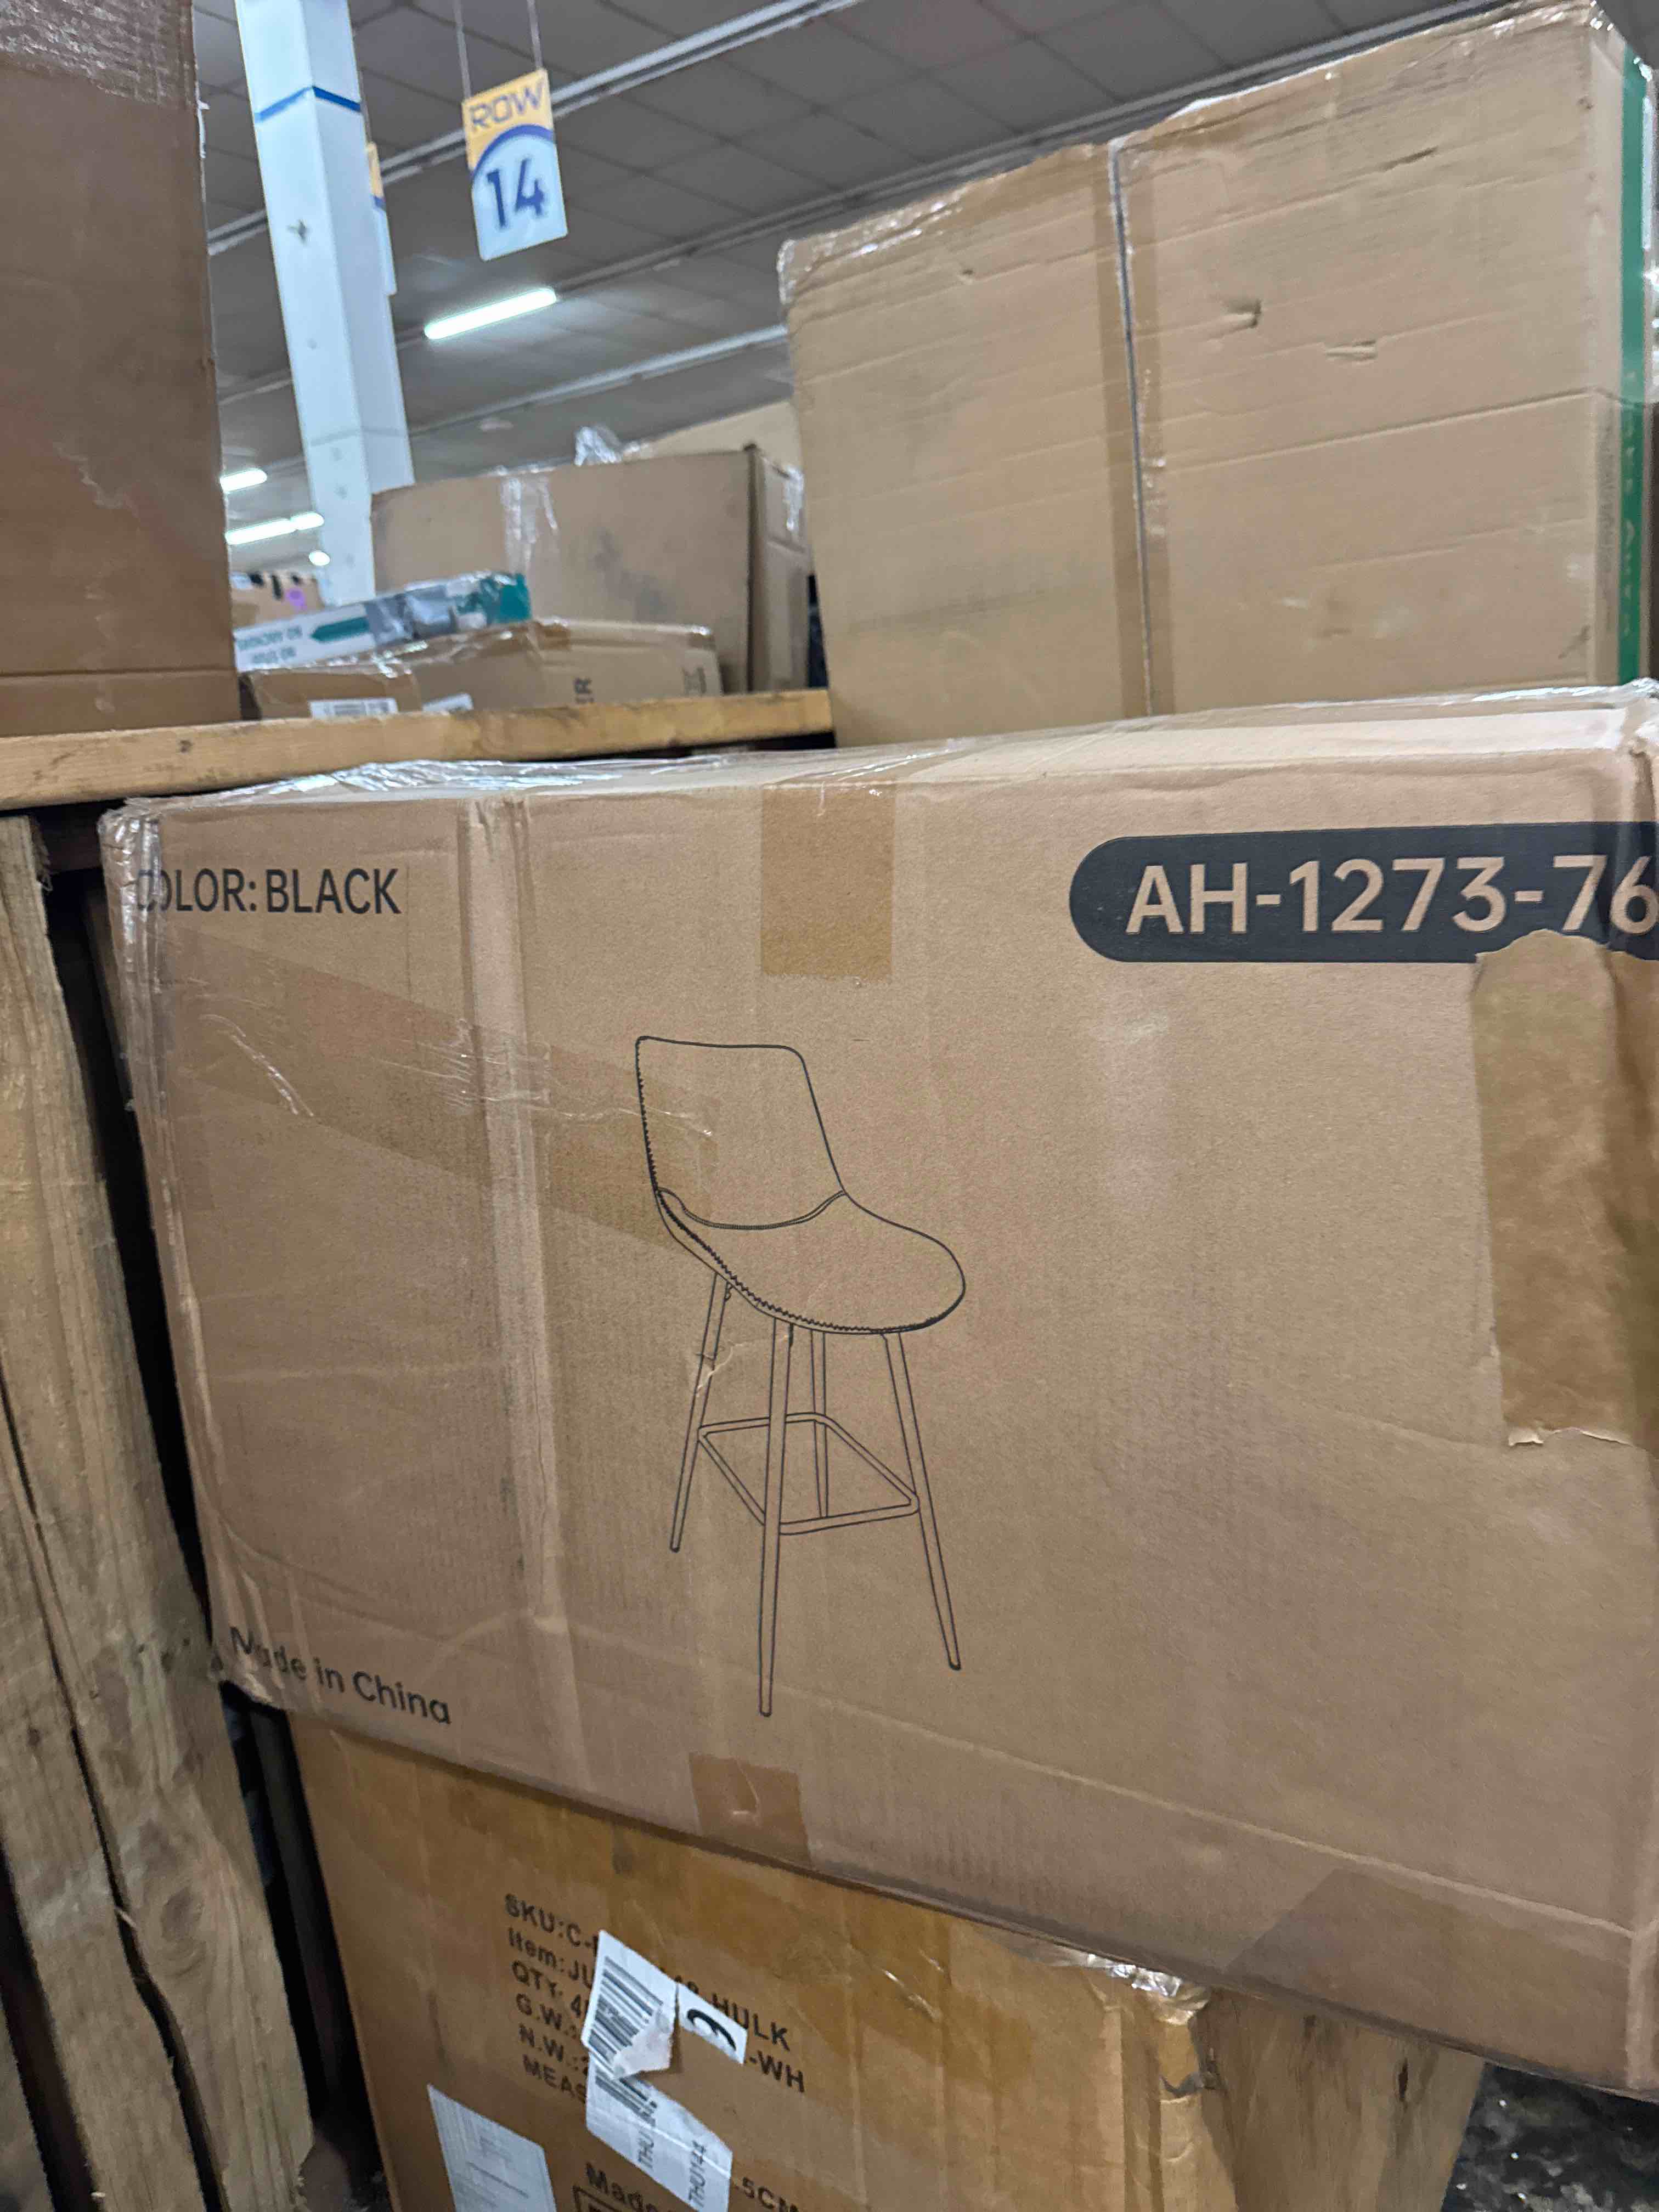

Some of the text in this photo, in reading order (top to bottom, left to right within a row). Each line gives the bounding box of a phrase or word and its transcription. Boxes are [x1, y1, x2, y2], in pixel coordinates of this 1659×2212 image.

[470, 79, 544, 131] ROW
[487, 155, 545, 229] 14
[1125, 854, 1659, 934] AH-1273-76
[314, 1657, 345, 1693] in
[352, 1671, 452, 1725] China
